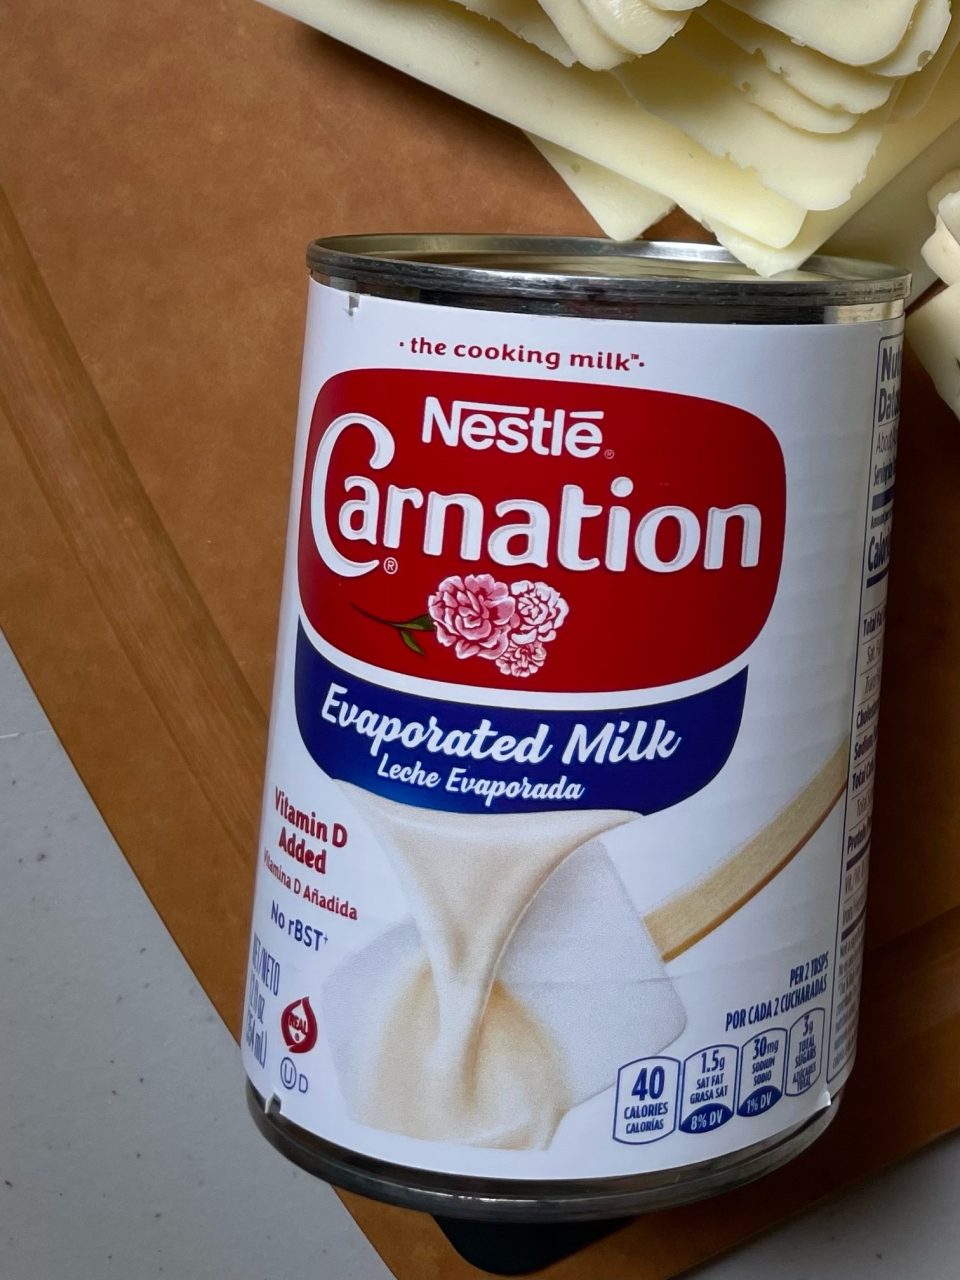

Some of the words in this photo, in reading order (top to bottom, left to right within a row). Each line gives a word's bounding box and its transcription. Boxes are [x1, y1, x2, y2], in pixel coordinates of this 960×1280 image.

[410, 337, 447, 356] the
[453, 344, 560, 370] cooking
[311, 412, 762, 578] Carnation
[320, 682, 553, 766] Evaporated
[562, 718, 682, 766] Milk
[376, 753, 442, 789] Leche
[445, 766, 585, 807] Evaporada
[275, 786, 328, 842] Vitamin
[332, 823, 348, 848] D
[278, 826, 327, 874] Added
[271, 899, 285, 929] No
[293, 878, 301, 895] D
[303, 885, 358, 920] Añadida
[790, 964, 804, 988] PER
[810, 951, 829, 978] TBSPS
[725, 1008, 746, 1032] POR
[748, 1000, 772, 1024] CADA
[780, 973, 827, 1013] CUCHARADAS
[701, 1049, 726, 1074] 1.5g
[752, 1036, 779, 1061] 30mg
[752, 1056, 776, 1075] SODIUM
[753, 1071, 773, 1087] SODIO
[631, 1066, 665, 1101] 40
[689, 1090, 713, 1105] GRASA
[714, 1085, 729, 1099] SAT
[696, 1076, 711, 1091] SAT
[711, 1073, 725, 1087] FAT
[624, 1102, 668, 1120] CALORIES
[760, 1091, 773, 1108] DV
[626, 1119, 664, 1134] CALORÍAS
[690, 1114, 708, 1131] 8%
[709, 1108, 724, 1126] DV
